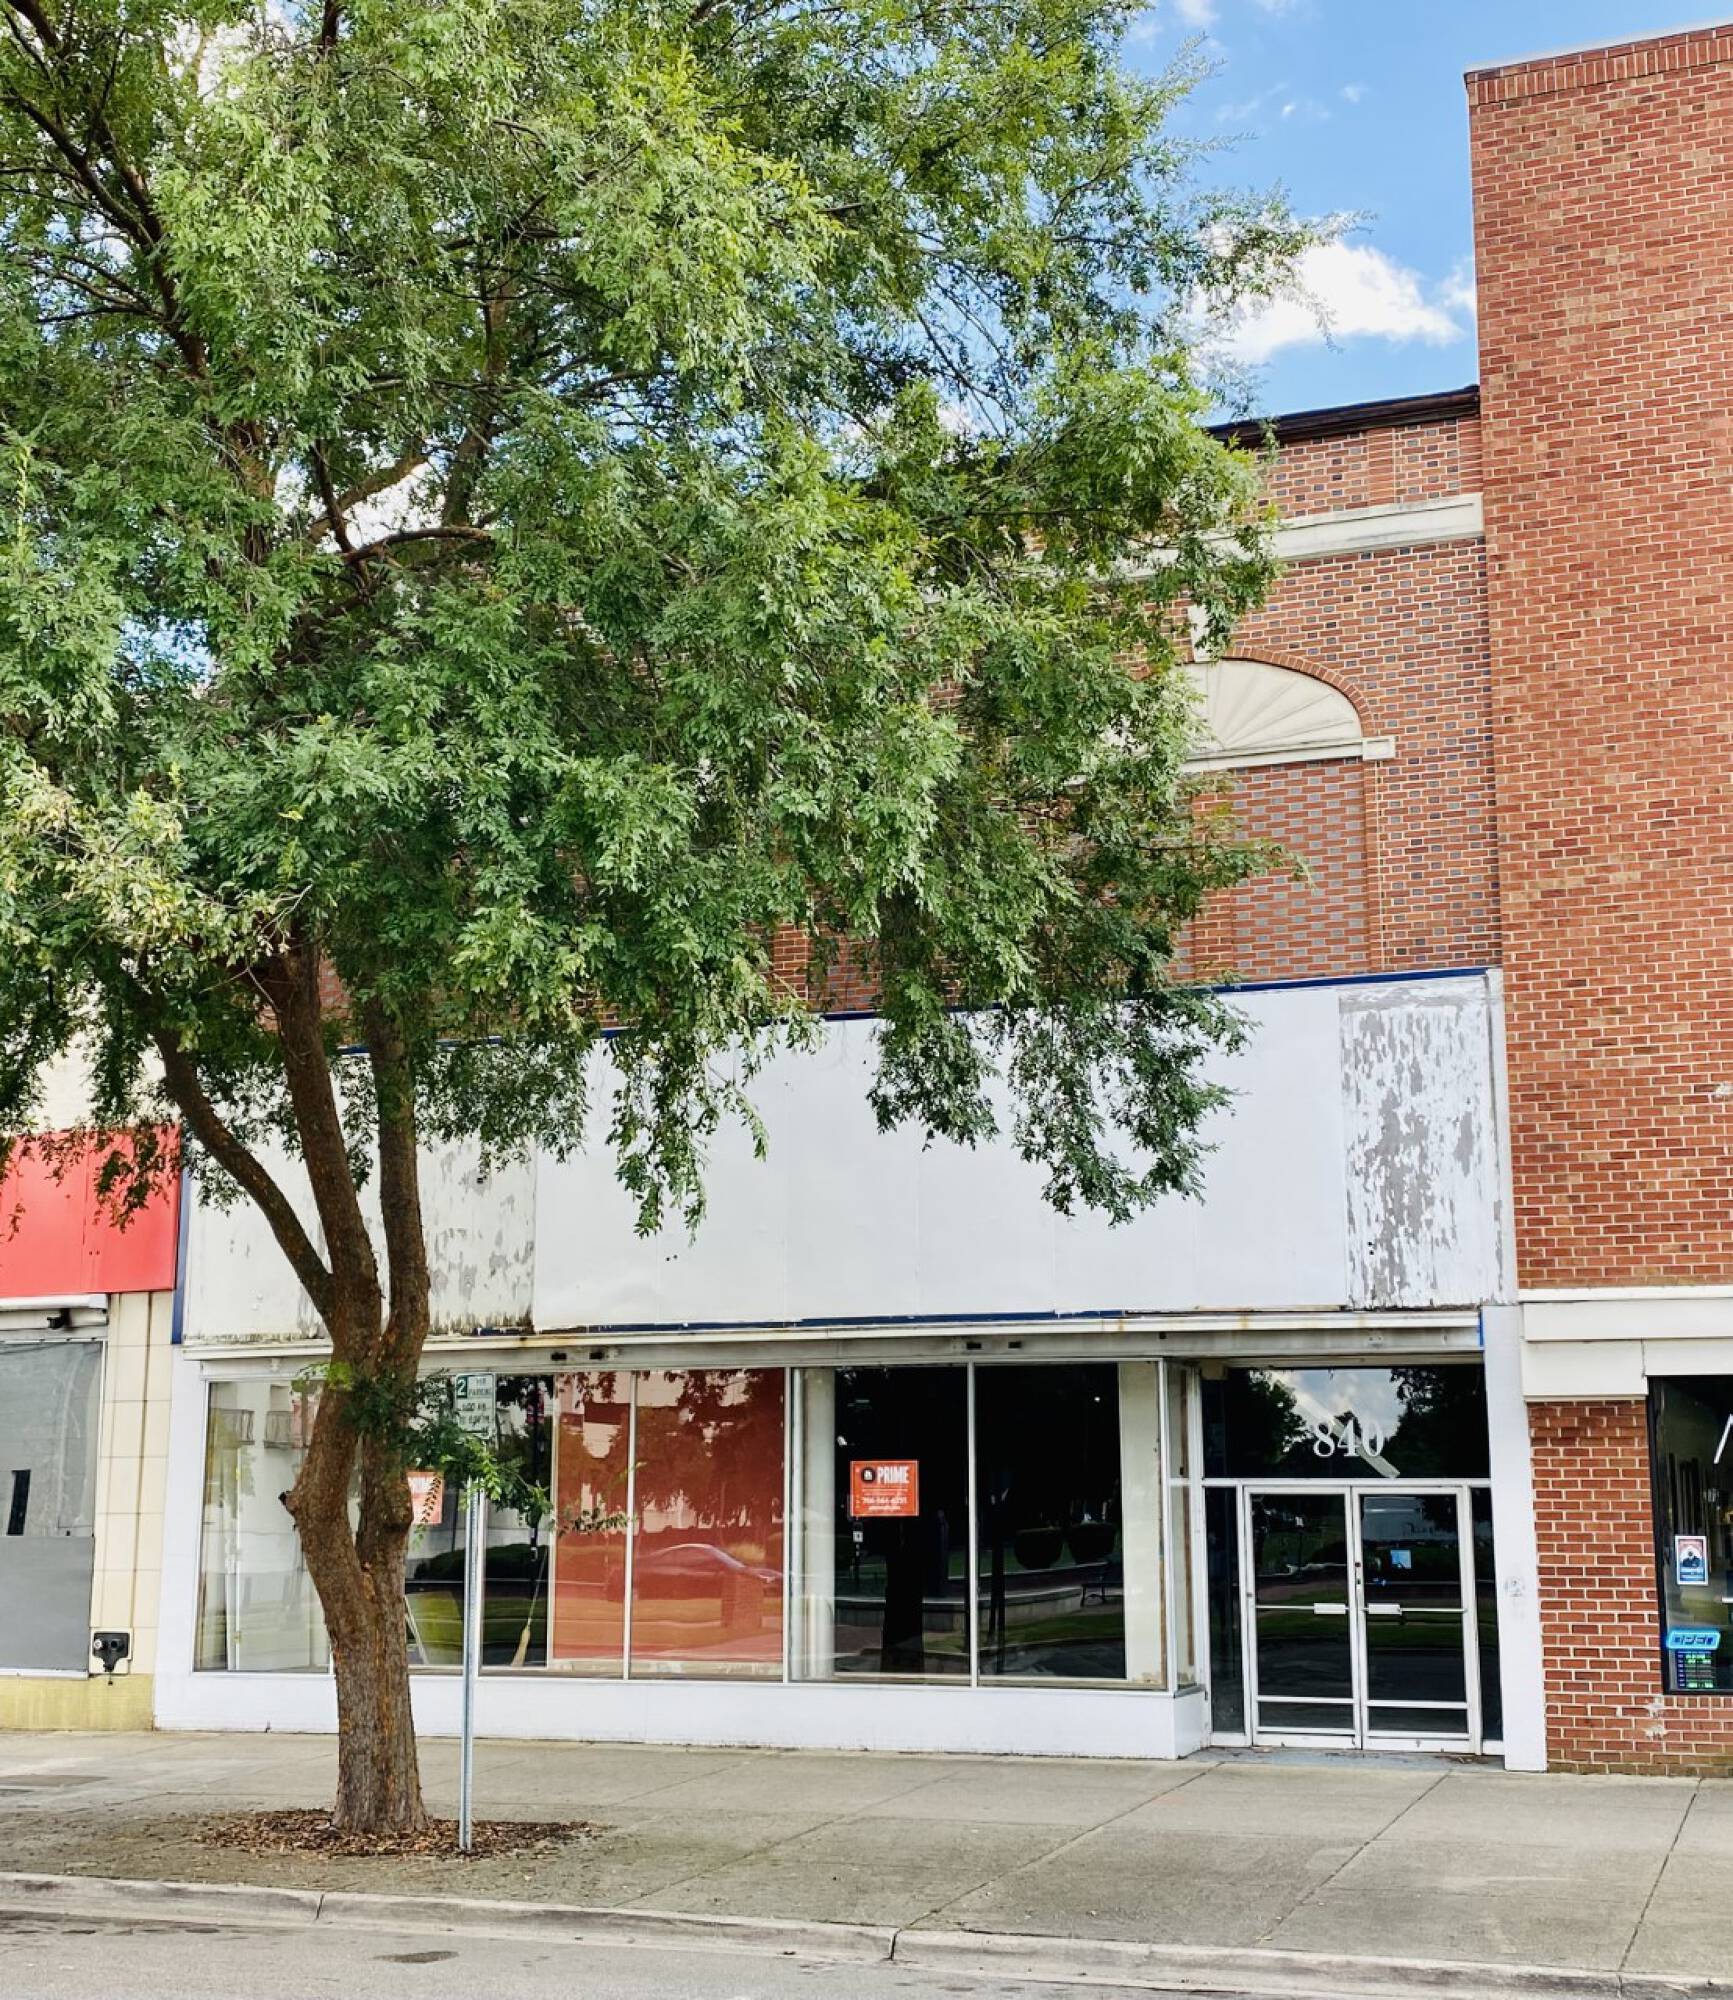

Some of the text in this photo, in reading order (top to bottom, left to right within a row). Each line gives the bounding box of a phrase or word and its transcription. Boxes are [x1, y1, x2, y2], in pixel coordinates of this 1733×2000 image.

[457, 1379, 467, 1396] 2
[1313, 1417, 1384, 1457] 840
[877, 1465, 910, 1484] PRIME
